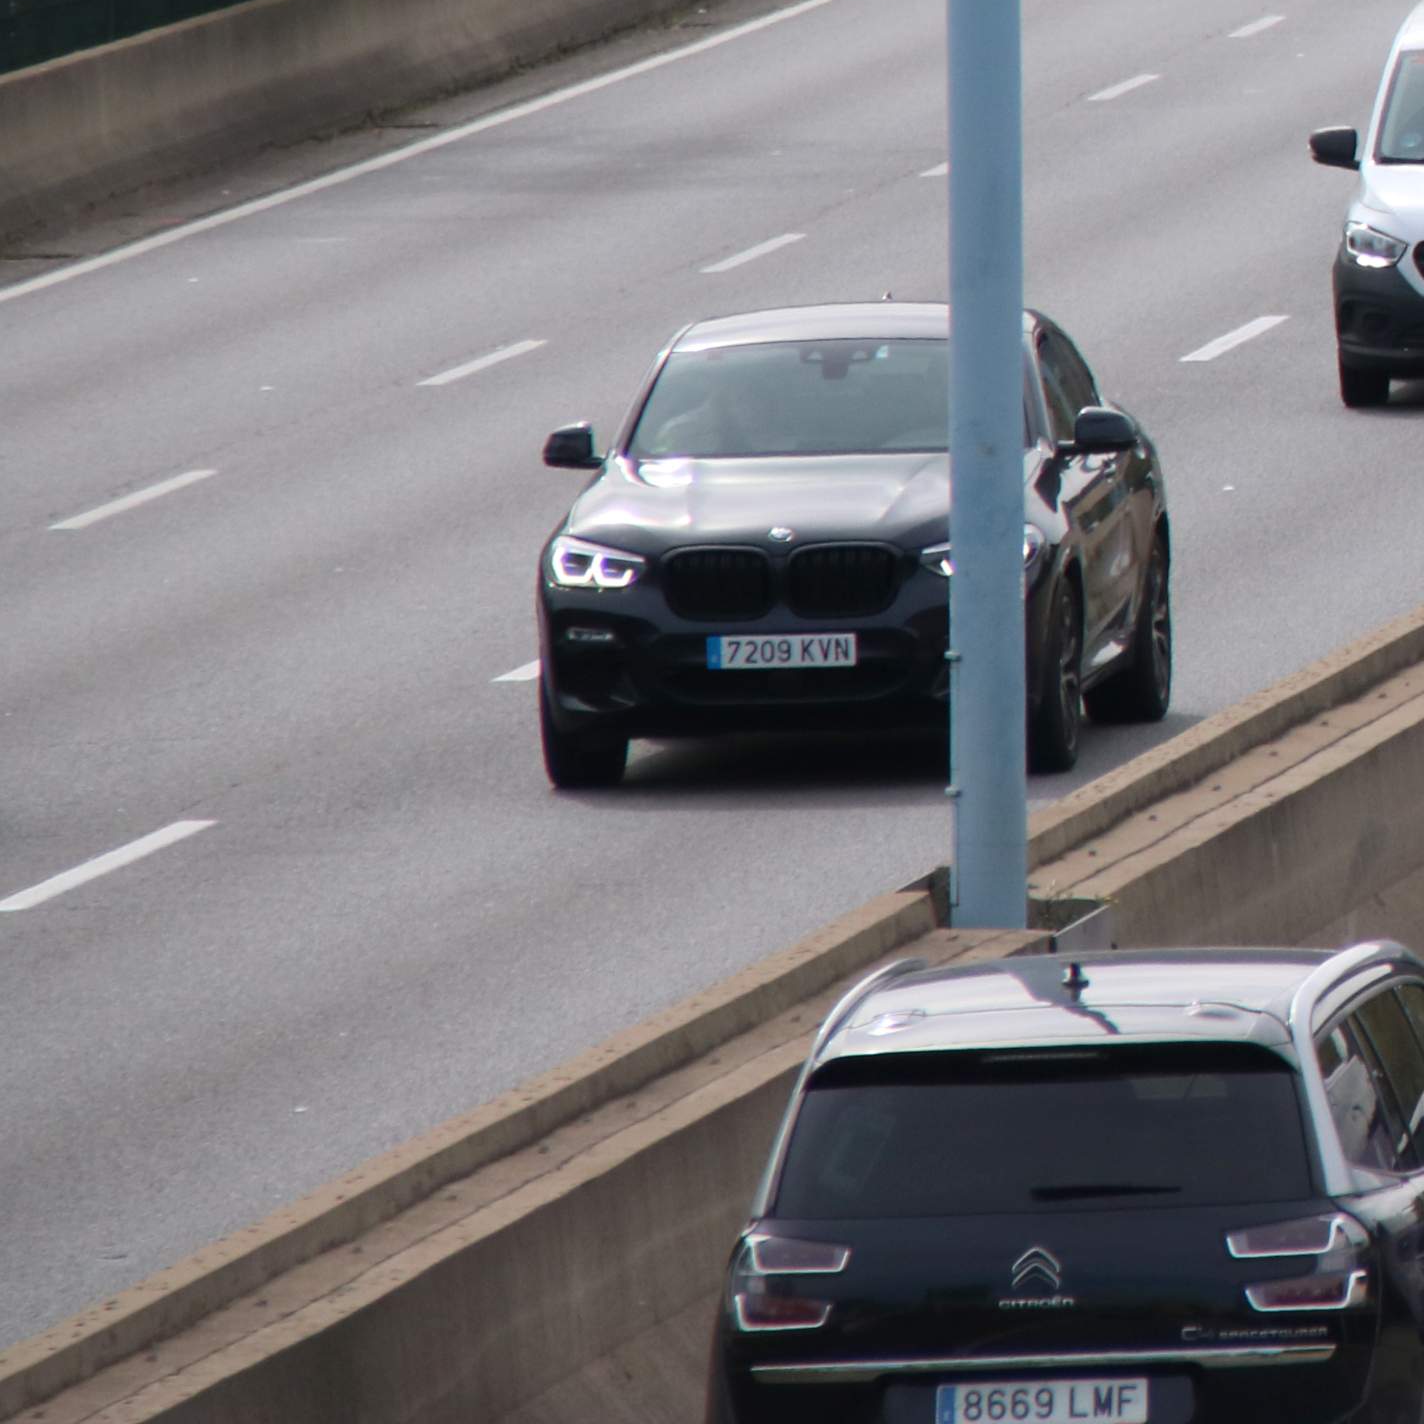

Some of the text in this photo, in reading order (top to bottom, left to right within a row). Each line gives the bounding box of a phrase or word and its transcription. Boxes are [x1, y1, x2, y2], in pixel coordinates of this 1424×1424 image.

[727, 637, 849, 664] 7209 KVN
[963, 1383, 1138, 1422] 8669 LMF
